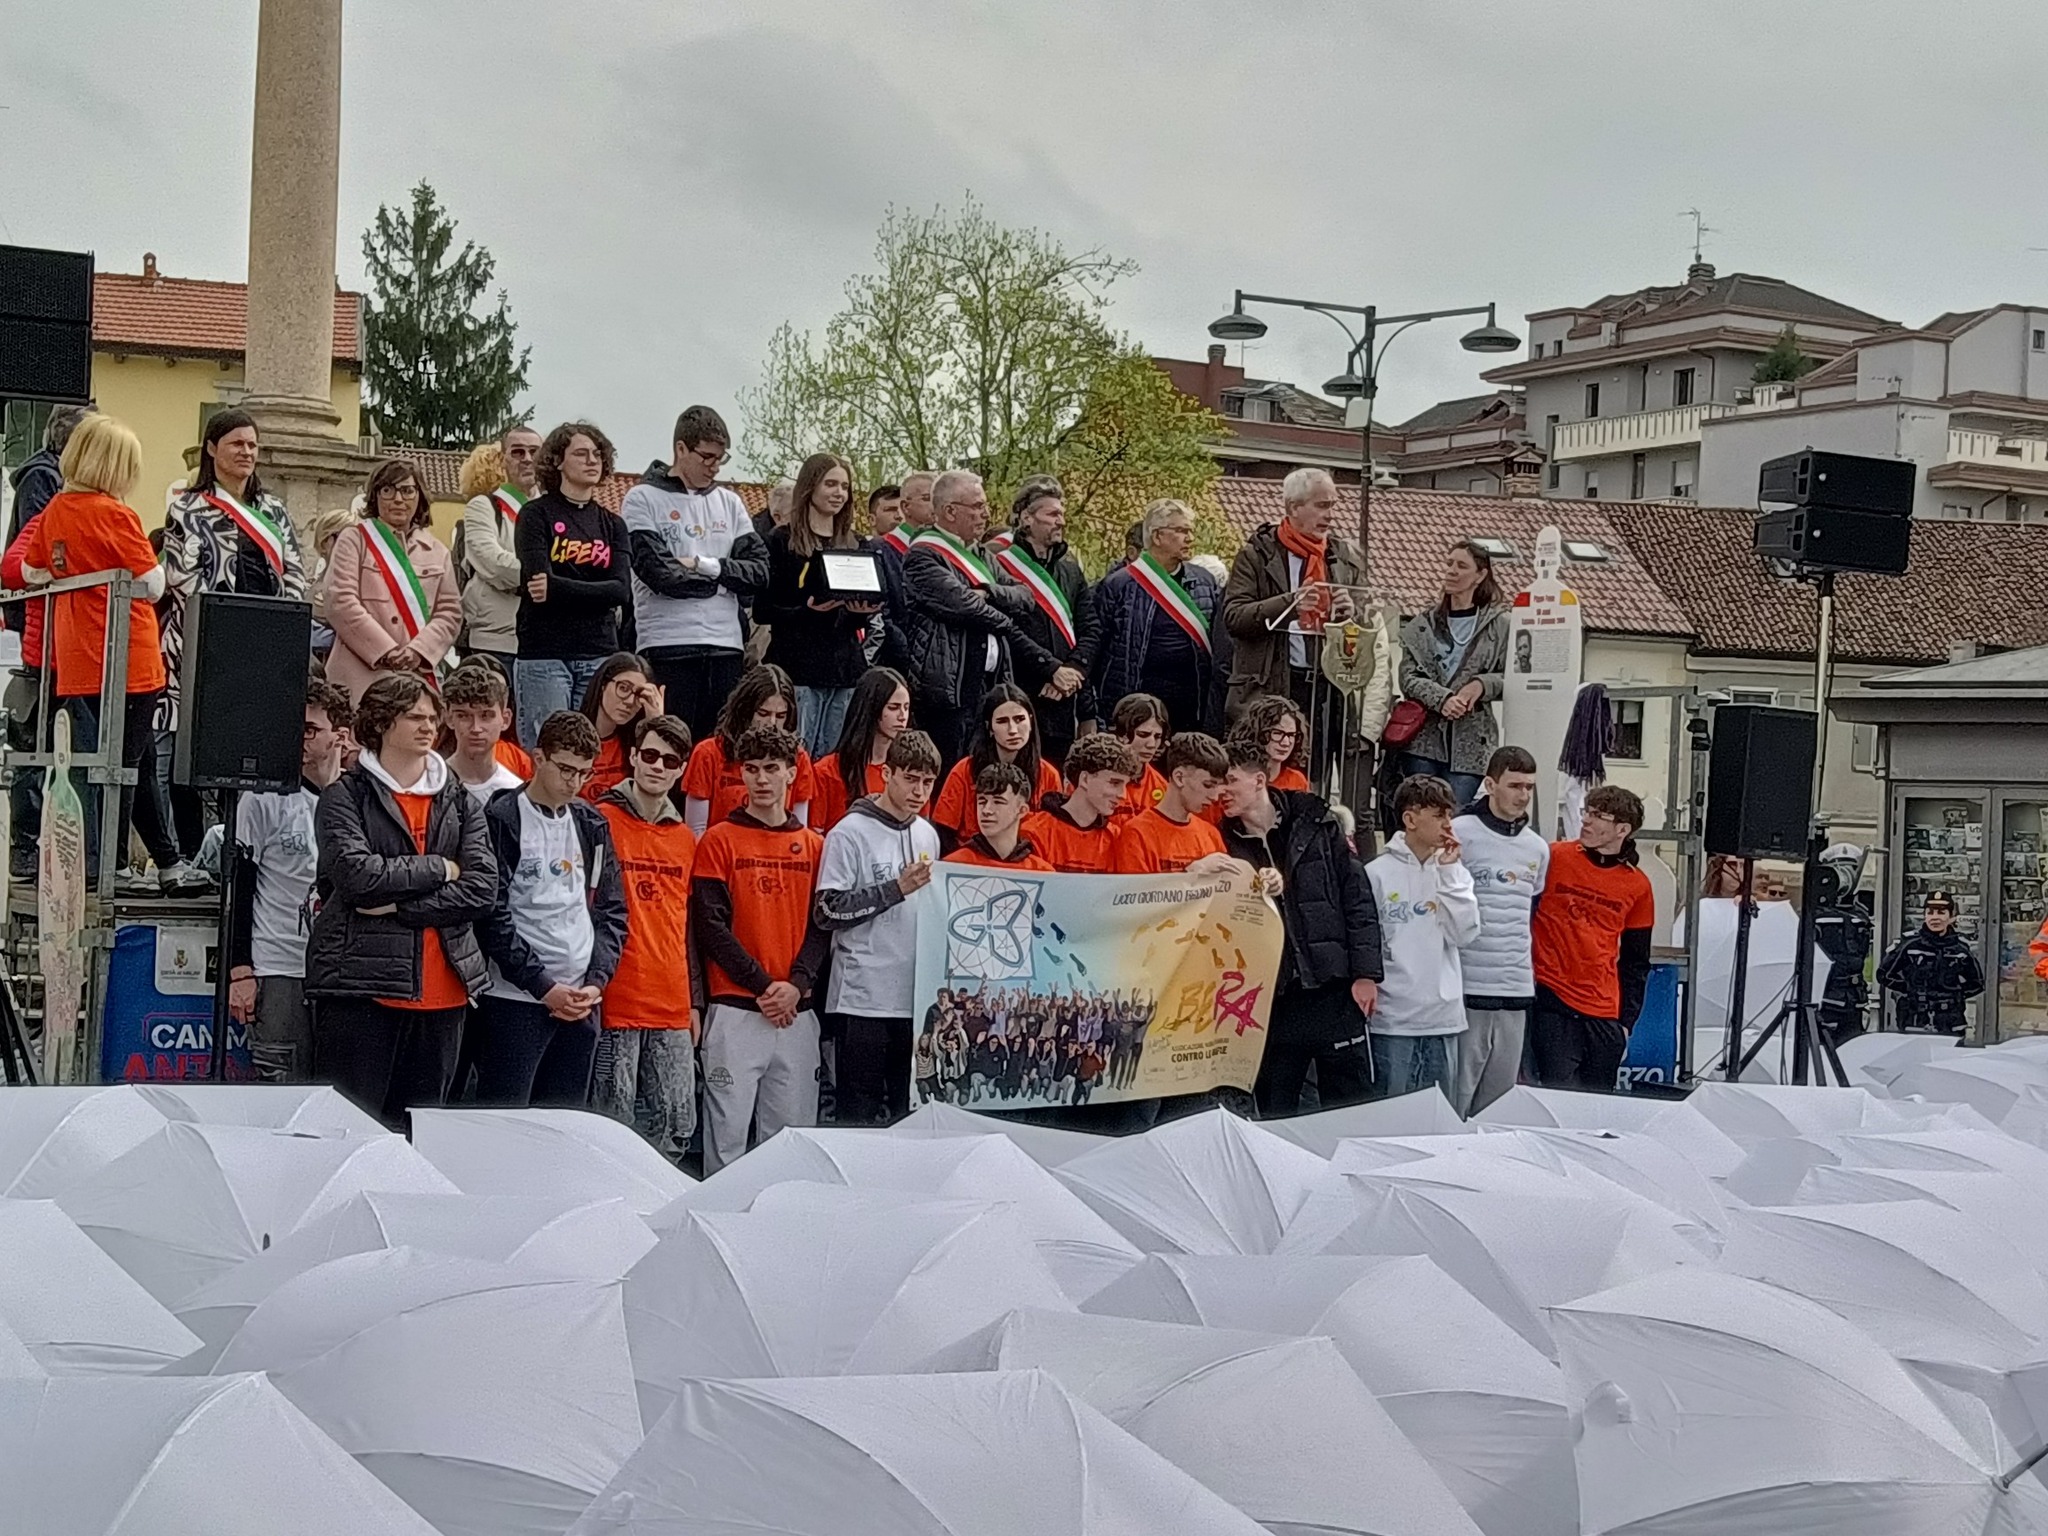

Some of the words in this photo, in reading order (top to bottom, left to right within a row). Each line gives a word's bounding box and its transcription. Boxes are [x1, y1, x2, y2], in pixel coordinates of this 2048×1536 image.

[1137, 889, 1183, 904] GIORDANO
[1171, 1051, 1204, 1063] CONTRO
[1614, 1066, 1665, 1090] RZO
